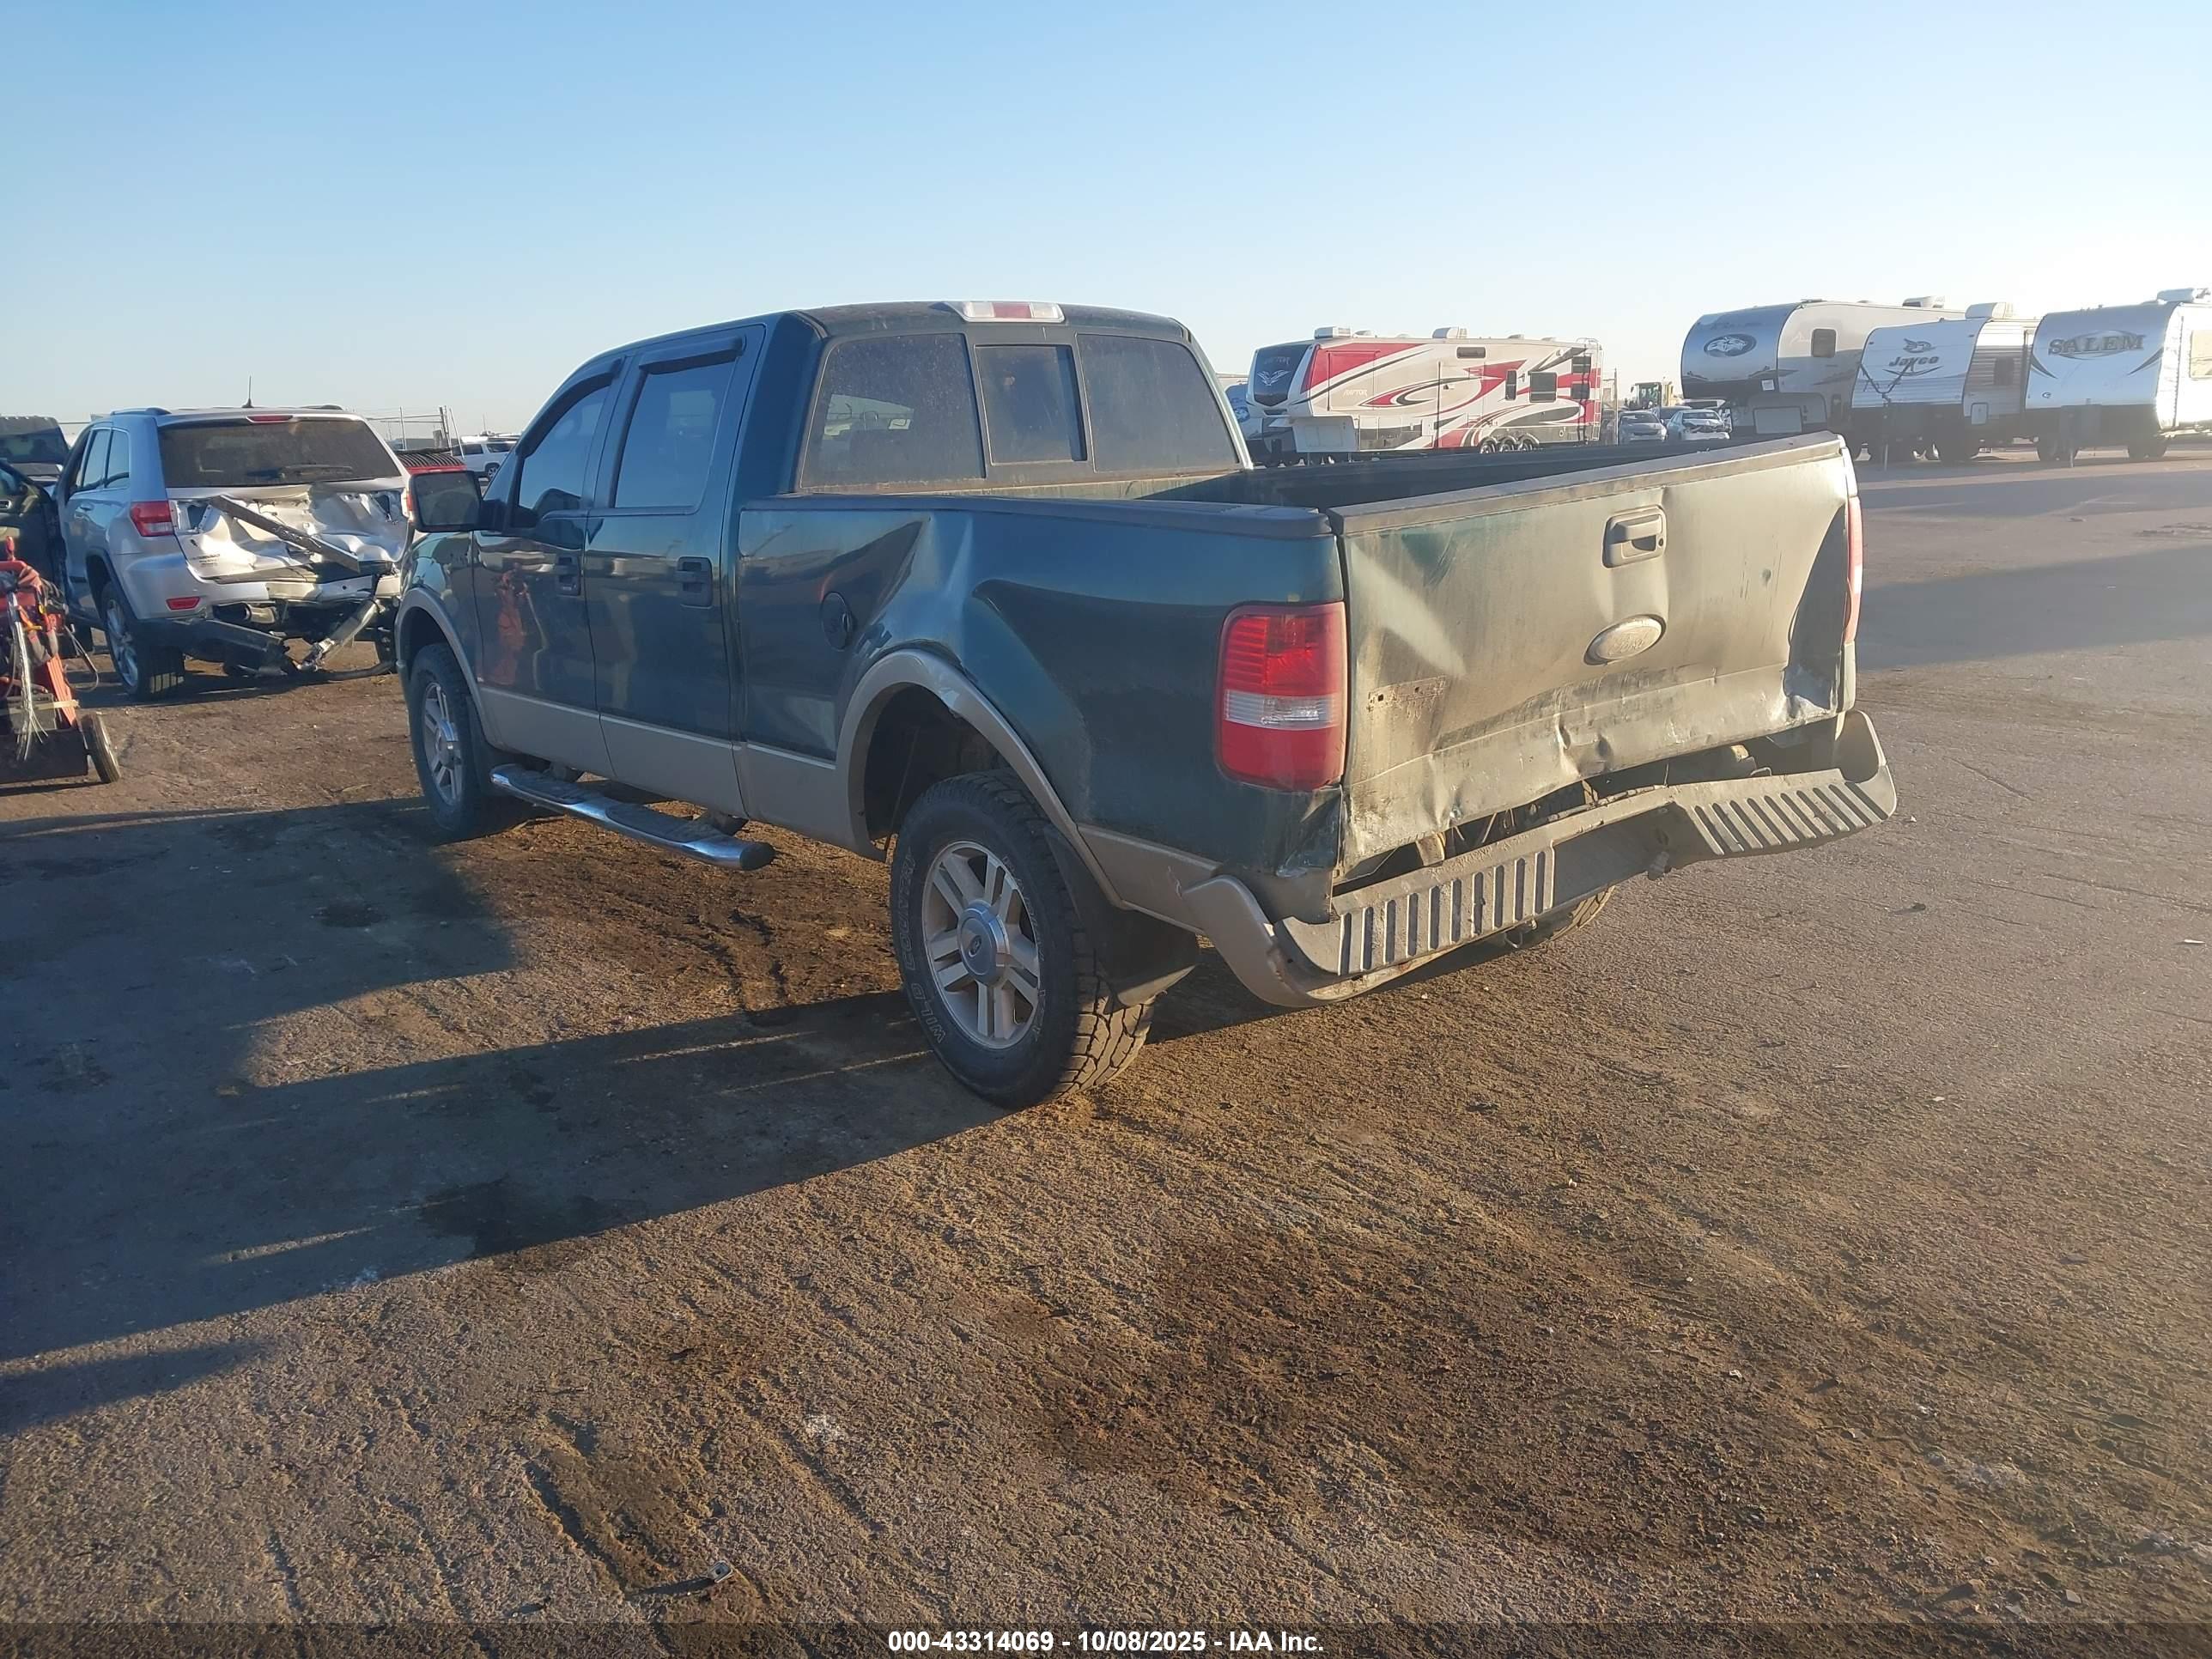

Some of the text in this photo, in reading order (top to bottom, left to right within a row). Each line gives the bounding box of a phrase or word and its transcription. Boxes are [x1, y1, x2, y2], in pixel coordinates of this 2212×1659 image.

[2048, 336, 2144, 356] SALEM
[1888, 356, 1940, 371] Jayco
[910, 982, 946, 1044] WILD
